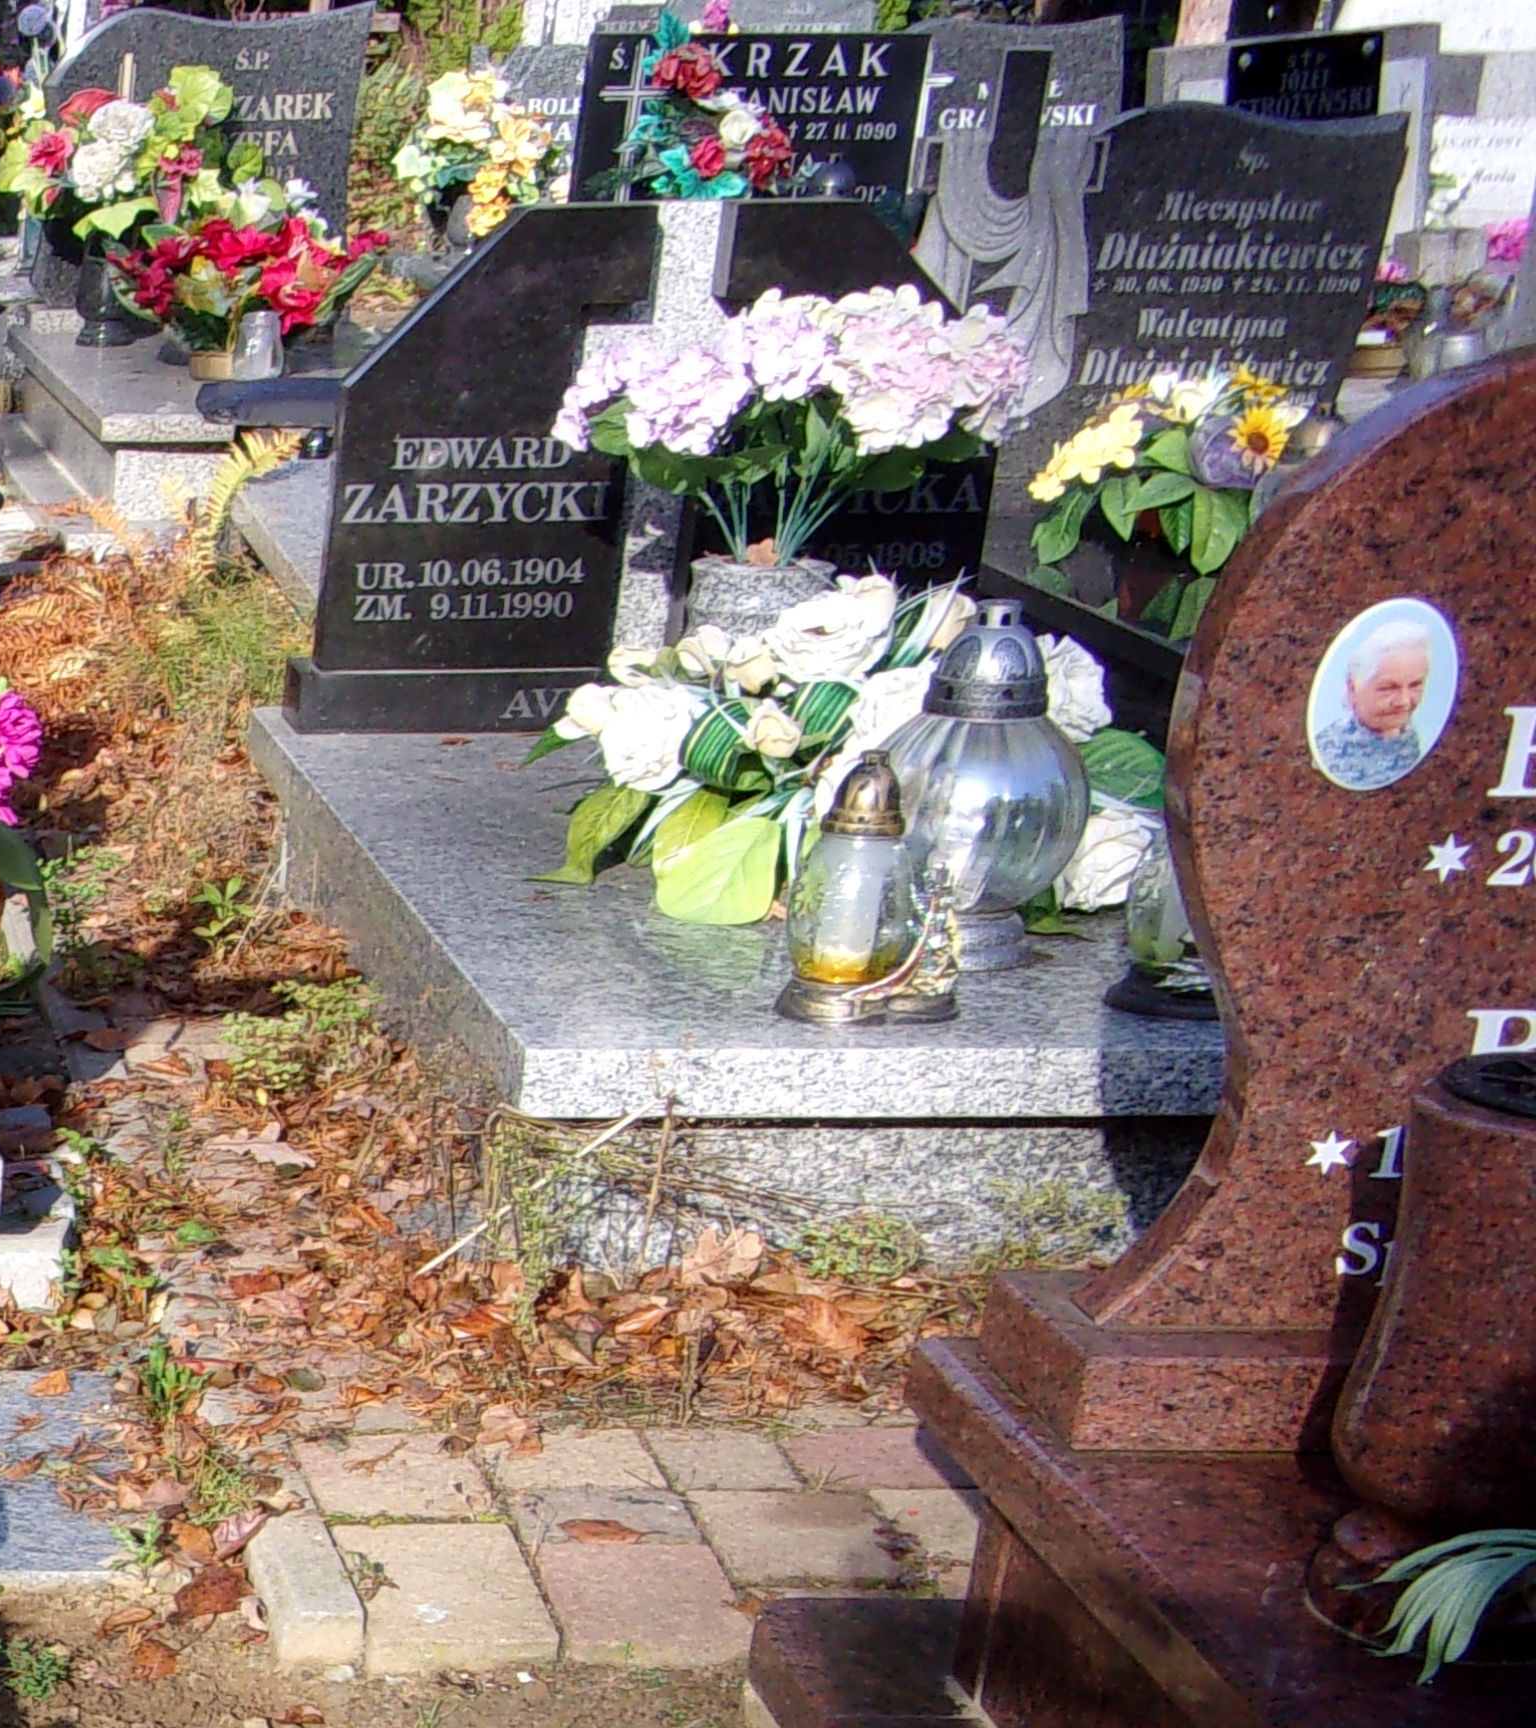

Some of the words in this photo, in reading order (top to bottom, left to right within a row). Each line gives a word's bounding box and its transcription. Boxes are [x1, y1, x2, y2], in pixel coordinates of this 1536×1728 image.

[728, 86, 881, 115] TANISŁAW
[1136, 307, 1289, 347] Walentyna
[391, 436, 572, 471] EDWARD
[341, 481, 612, 525] ZARZYCKI
[353, 594, 413, 622] ZM.
[429, 591, 574, 621] 9.11.1990
